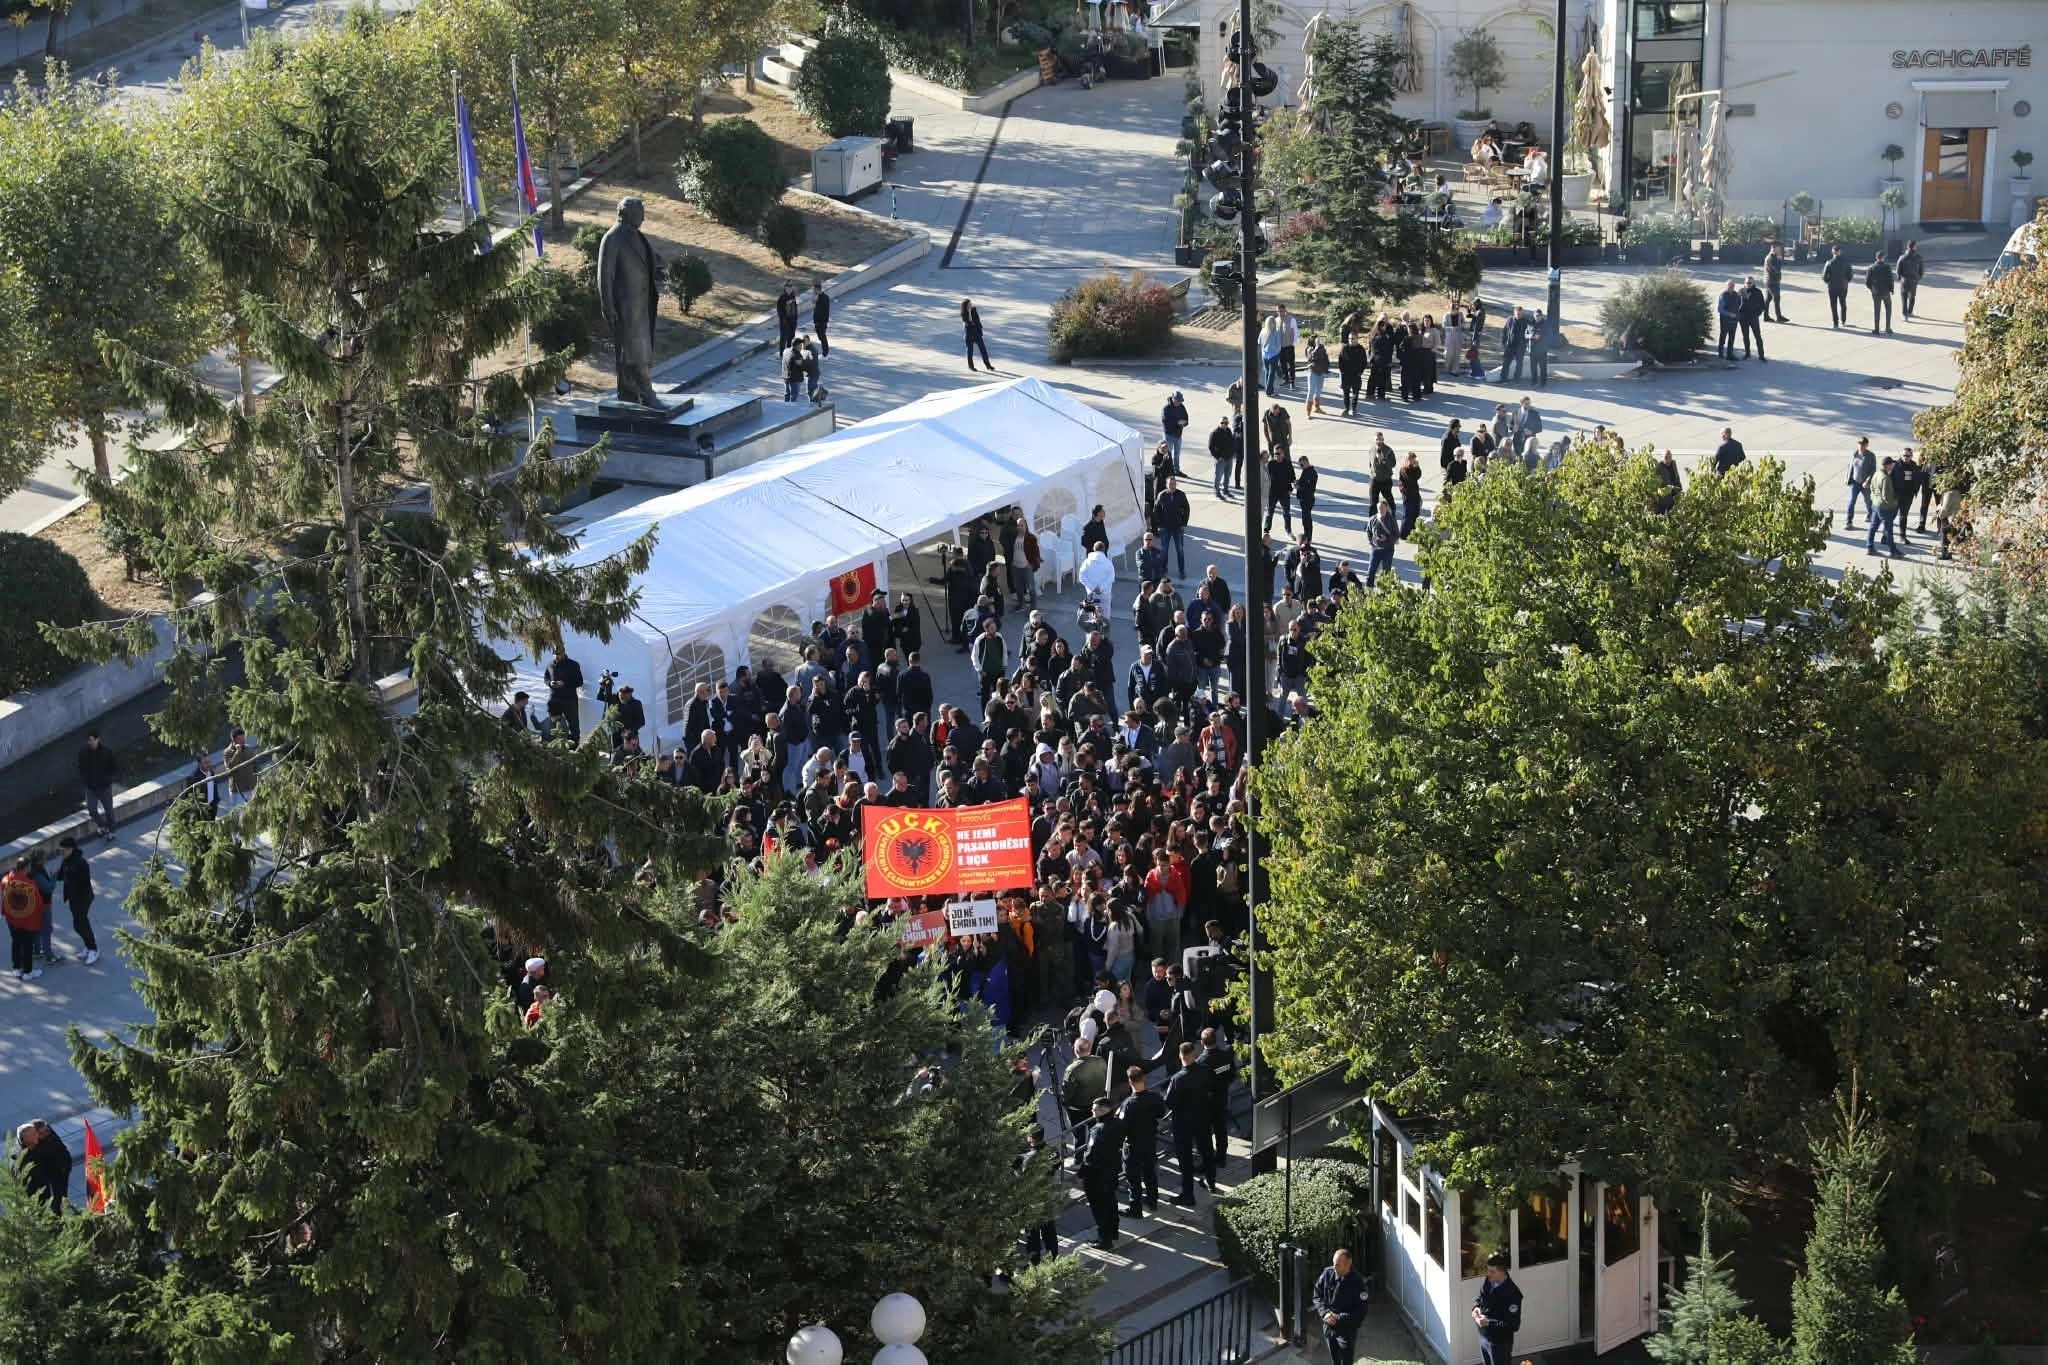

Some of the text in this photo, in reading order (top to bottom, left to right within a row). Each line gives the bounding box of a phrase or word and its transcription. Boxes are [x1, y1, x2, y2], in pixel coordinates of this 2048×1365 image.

[1892, 44, 2032, 68] SACHCAFFÉ
[952, 909, 963, 919] JO
[952, 918, 977, 929] EMRIN
